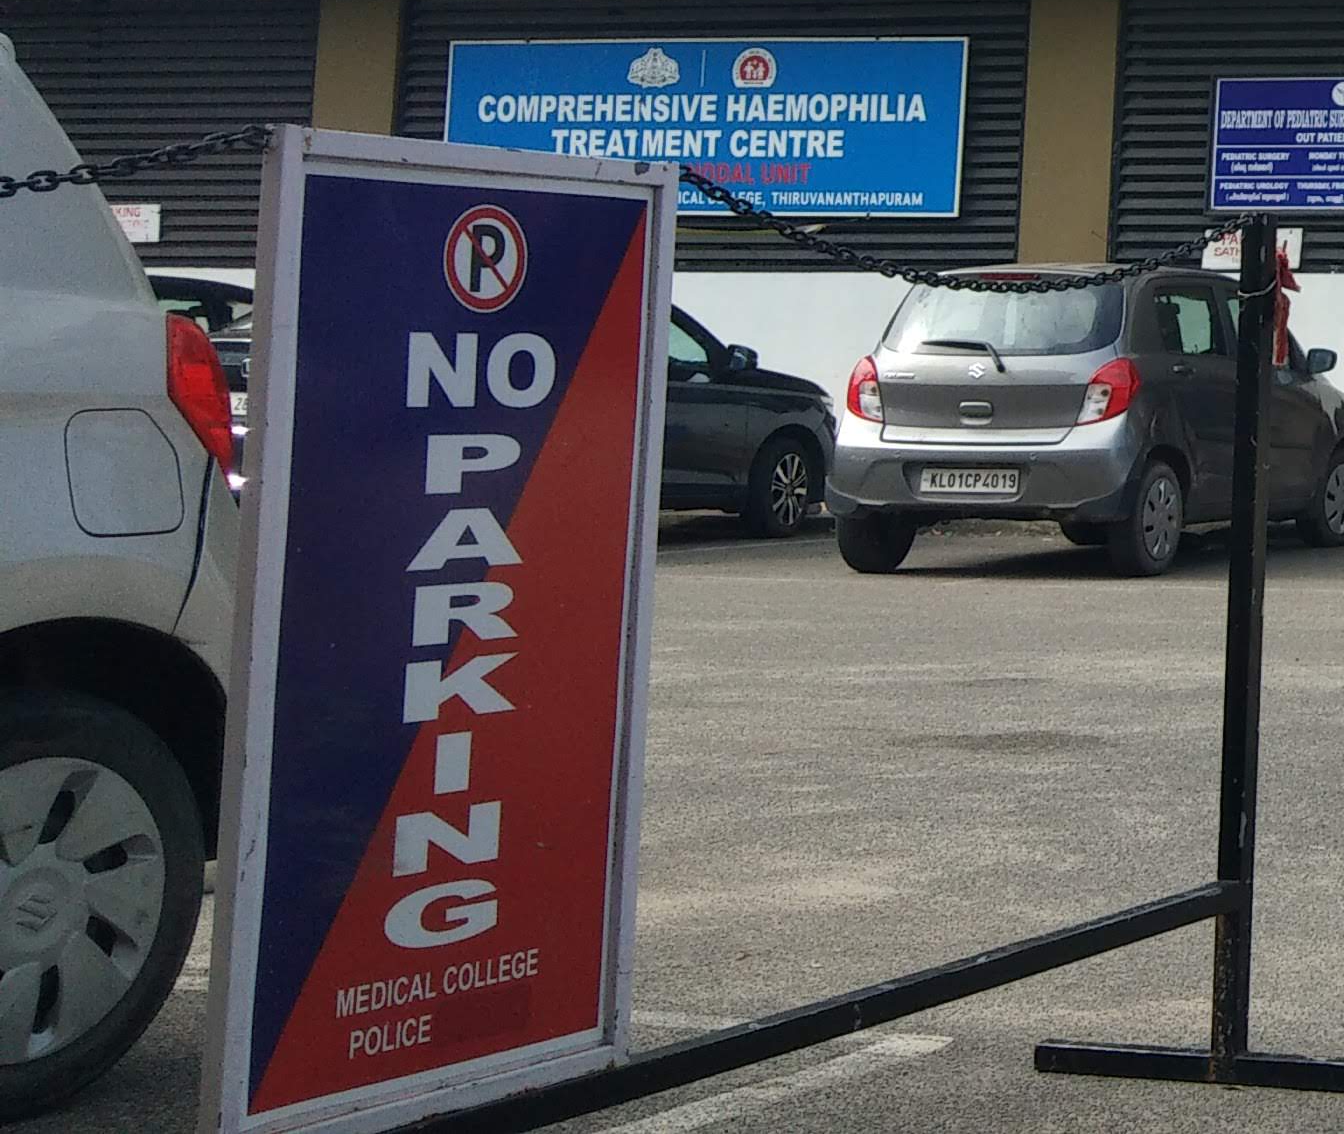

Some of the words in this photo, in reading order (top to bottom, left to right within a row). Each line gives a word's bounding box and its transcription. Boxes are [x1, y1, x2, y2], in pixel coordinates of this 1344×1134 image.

[478, 94, 718, 122] COMPREHENSIVE
[726, 94, 927, 122] HAEMOPHILIA
[1220, 110, 1273, 129] DEPARTMENT
[1274, 110, 1286, 129] OF
[1286, 109, 1328, 128] PEDIATRIC
[551, 129, 722, 158] TREATMENT
[729, 130, 845, 158] CENTRE
[1295, 132, 1316, 143] OUT
[761, 161, 812, 185] UNIT
[677, 191, 705, 205] ICAL
[771, 191, 924, 206] THIRUVANANTHAPURAM
[405, 331, 557, 408] NO
[929, 472, 1017, 490] KL01CP4019
[384, 433, 524, 949] PARKING
[335, 971, 437, 1019] MEDICAL
[442, 947, 540, 996] COLLEGE
[349, 1014, 433, 1060] POLICE
